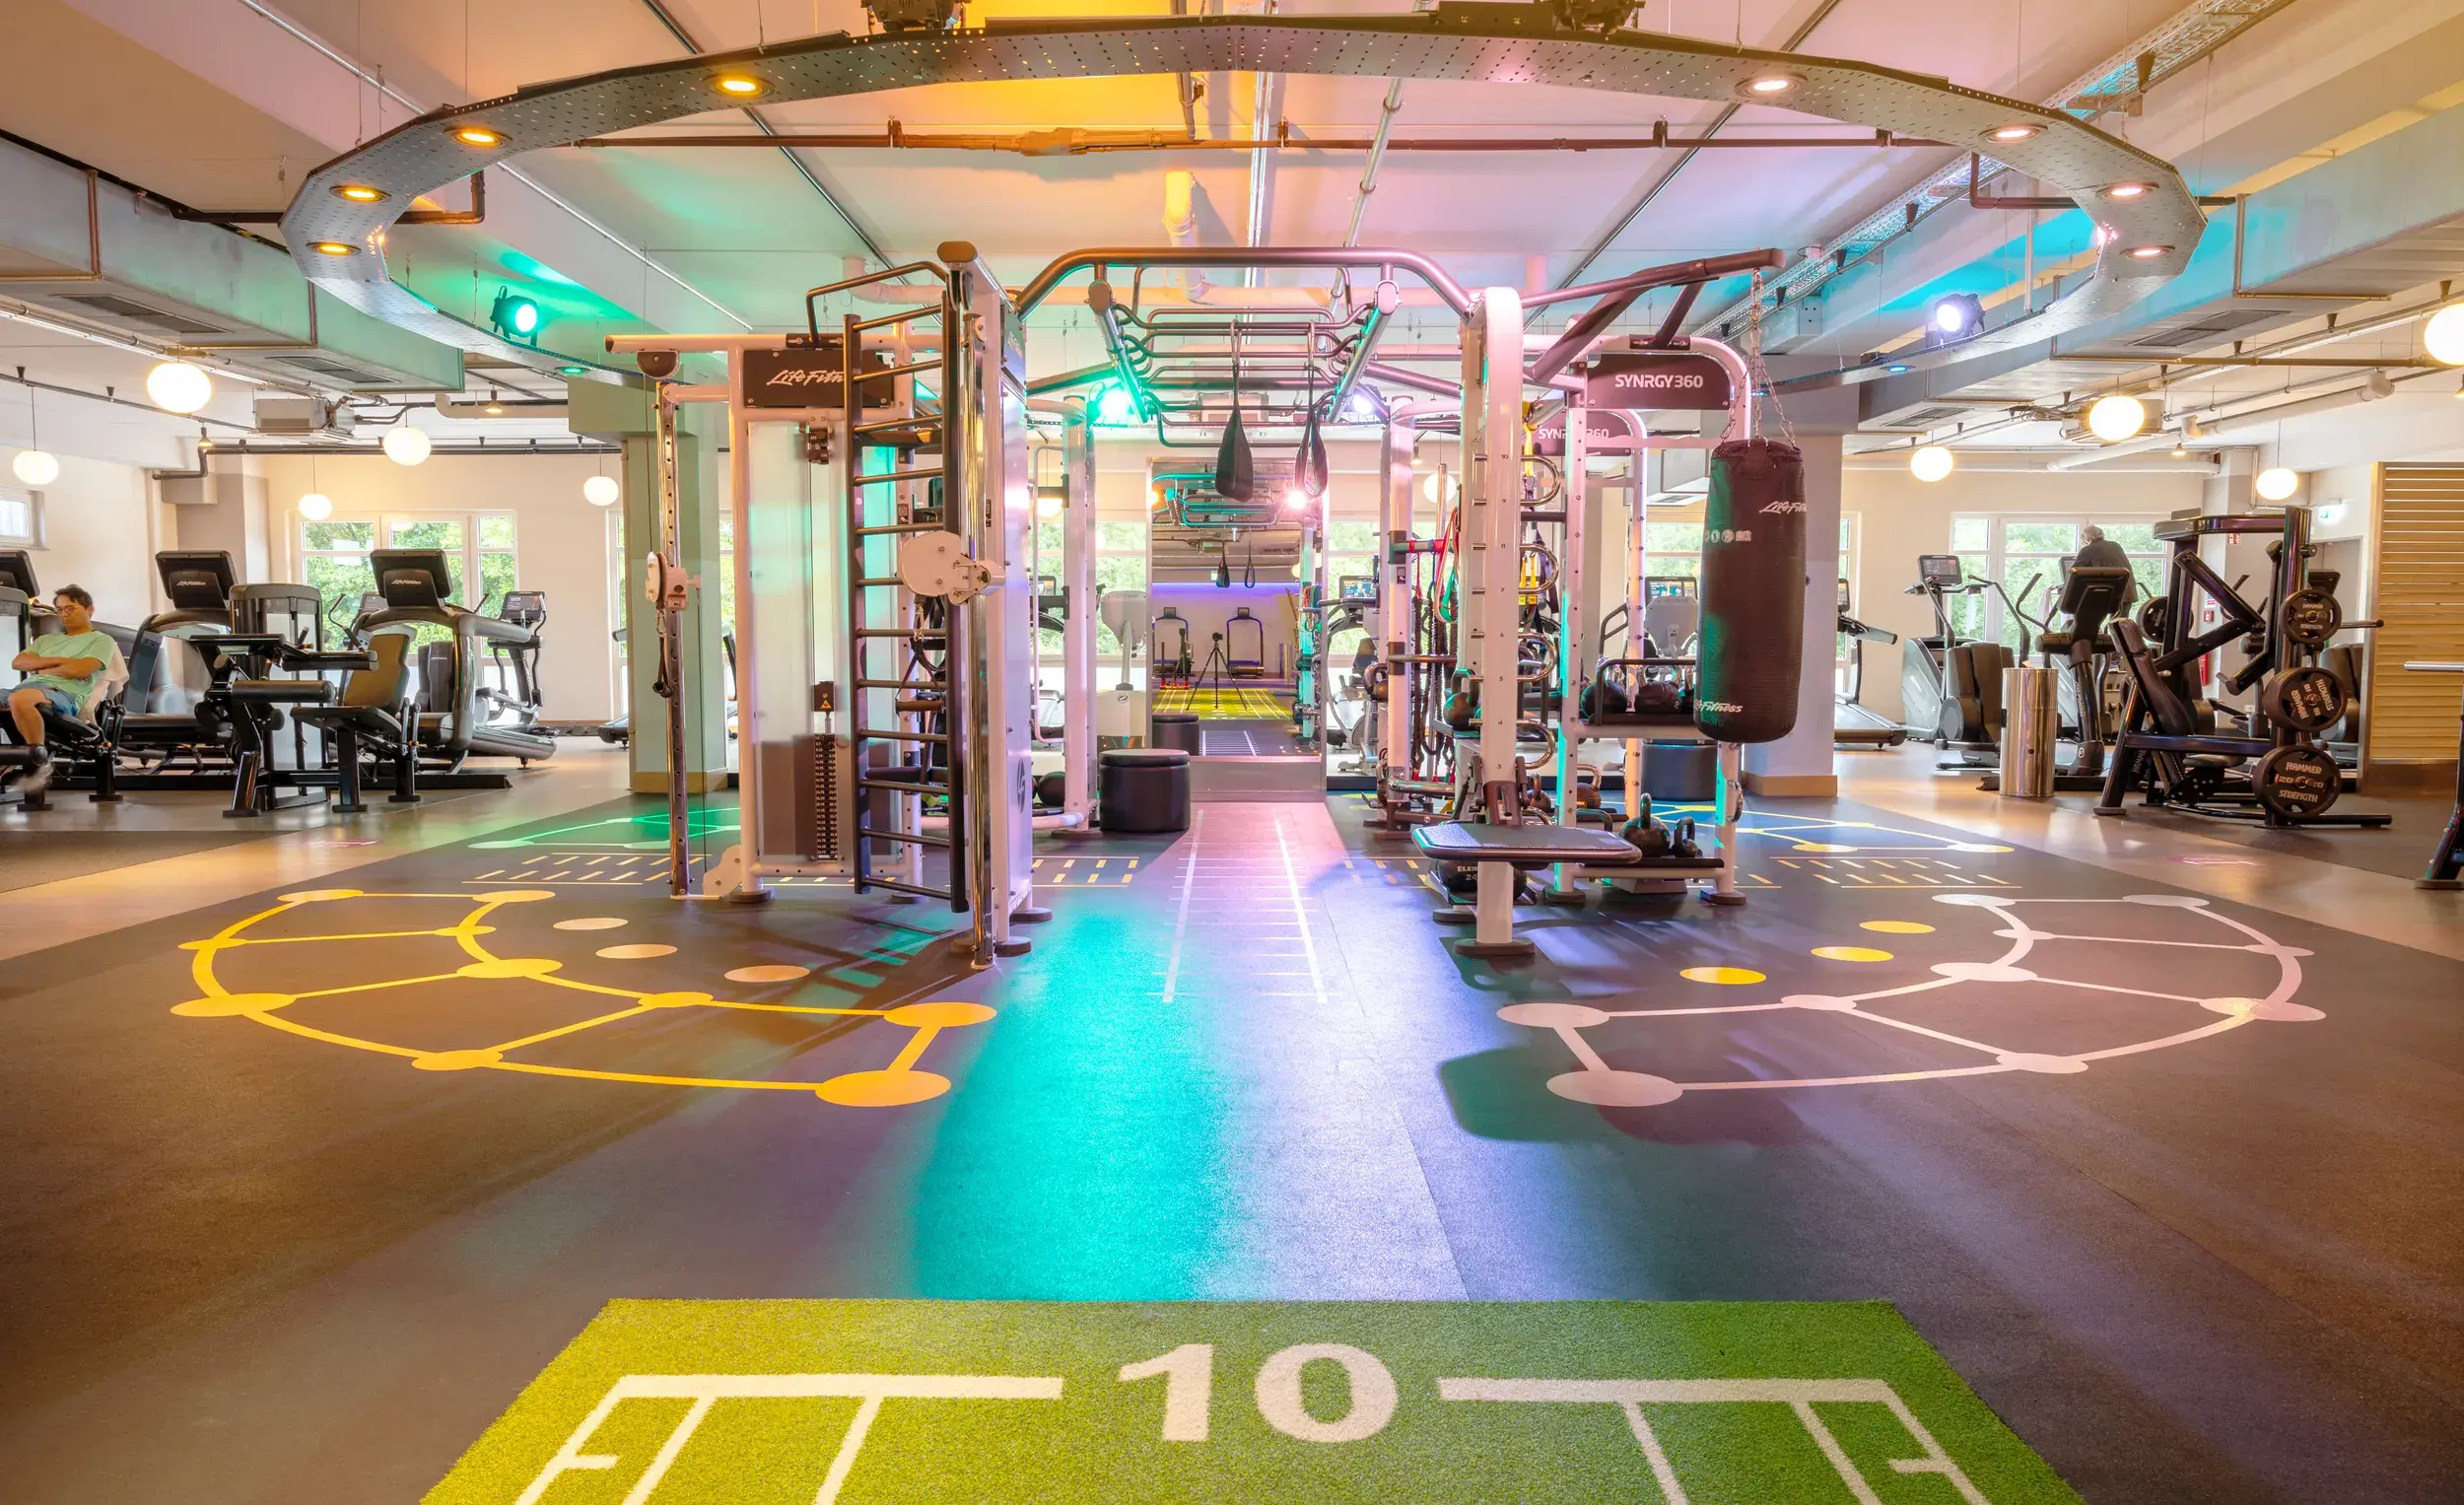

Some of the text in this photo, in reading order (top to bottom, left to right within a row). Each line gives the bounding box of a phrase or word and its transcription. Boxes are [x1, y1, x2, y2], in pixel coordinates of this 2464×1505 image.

[803, 370, 845, 386] Fitn
[1614, 375, 1704, 388] SYNRGY360
[2315, 678, 2335, 712] STRENGTH
[2291, 689, 2309, 719] HAMMER
[2286, 761, 2322, 775] HAMMER
[2278, 788, 2318, 802] STRENGTH
[1119, 1343, 1399, 1442] 10
